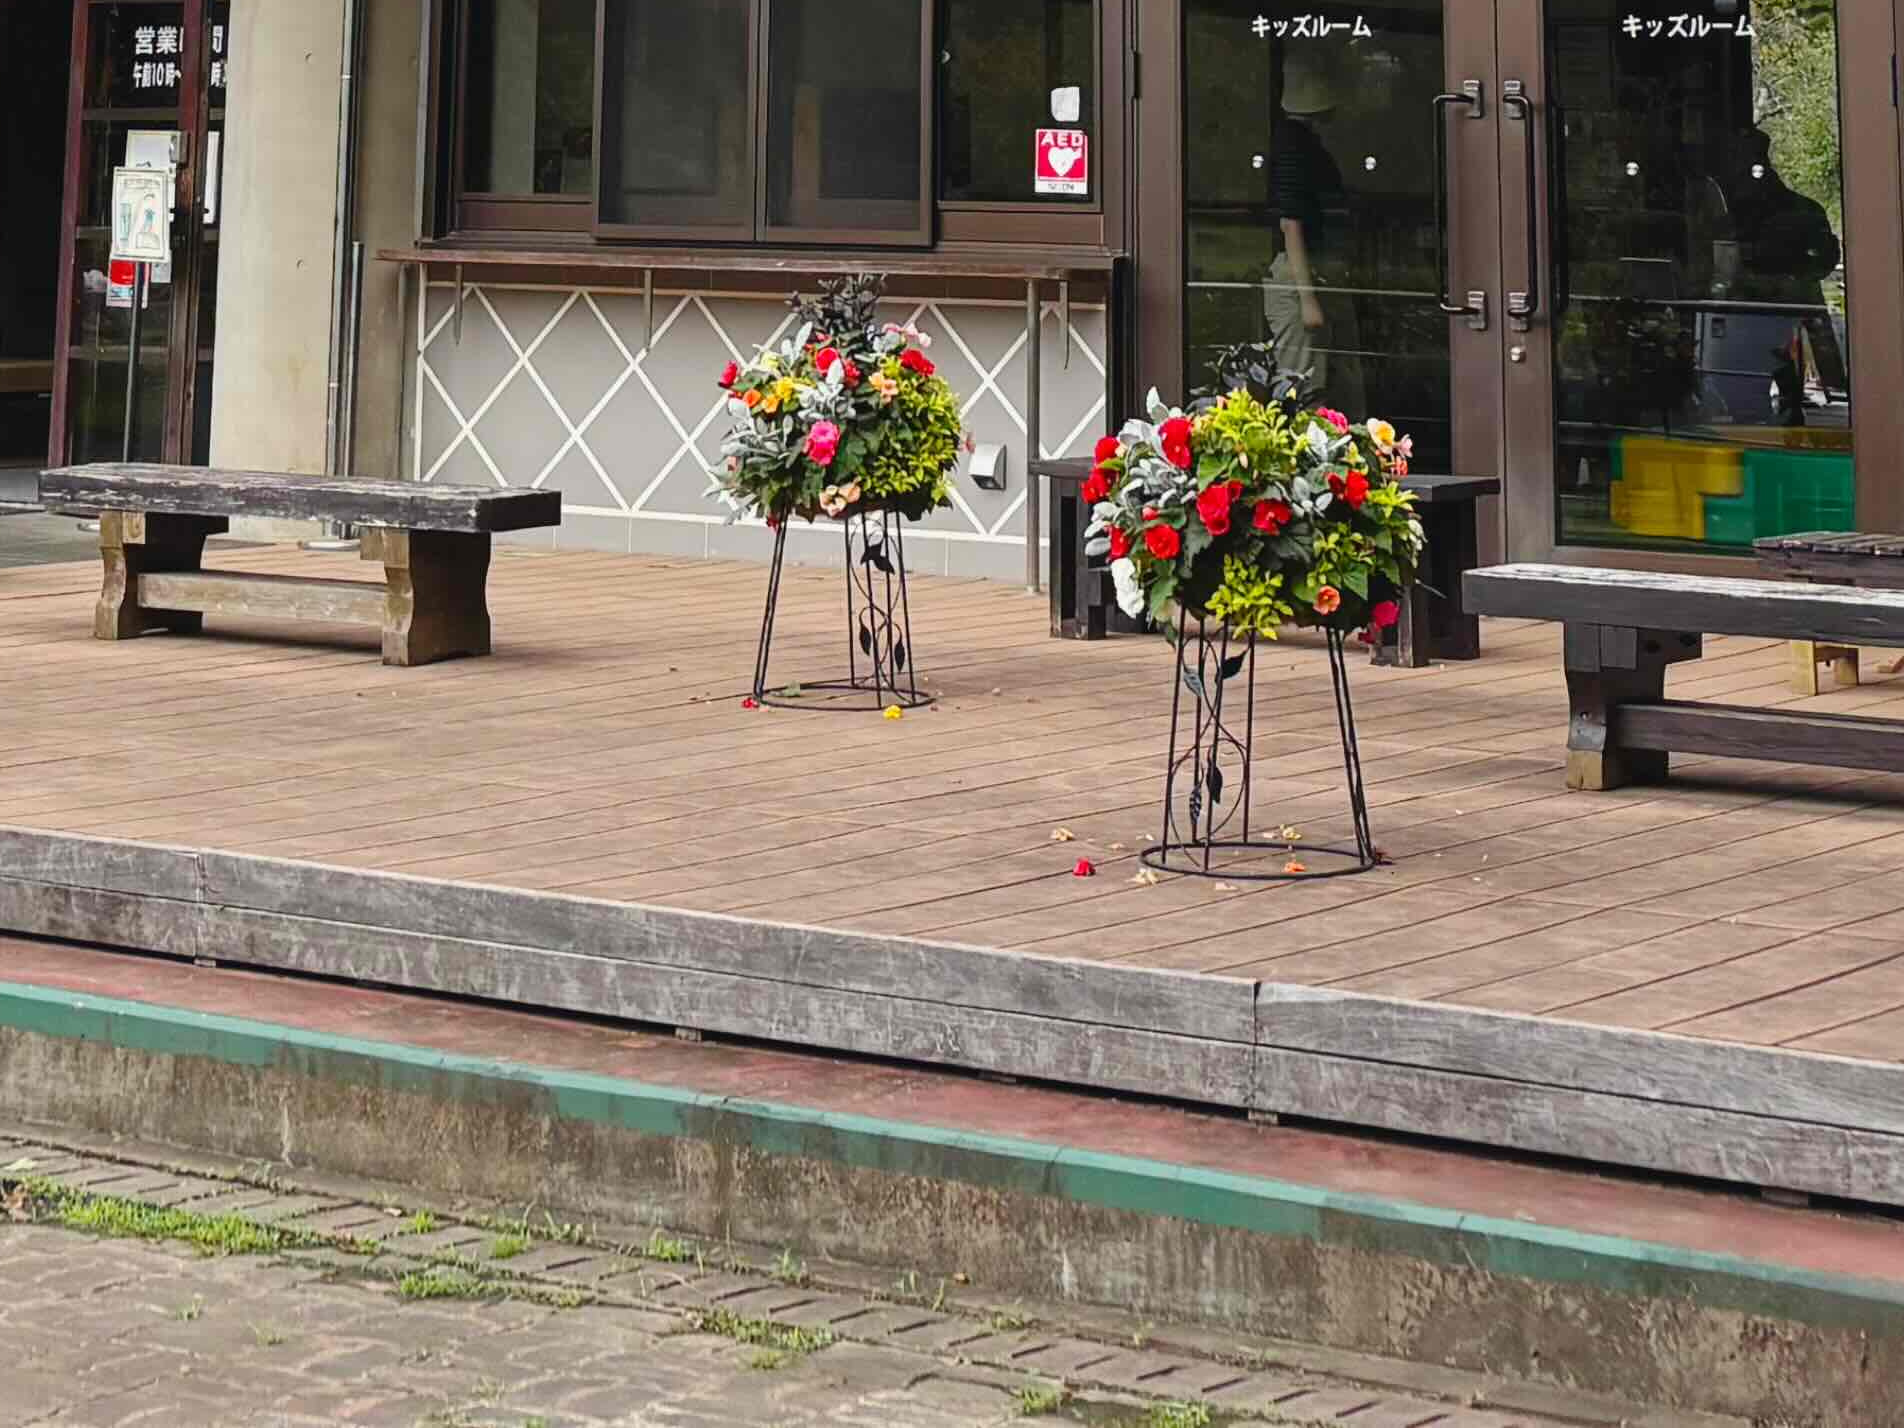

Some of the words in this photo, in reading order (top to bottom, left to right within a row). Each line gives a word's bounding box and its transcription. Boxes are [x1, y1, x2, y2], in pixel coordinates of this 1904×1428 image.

[1251, 13, 1372, 38] キッズルーム
[1622, 13, 1757, 38] キッズルーム
[1040, 132, 1084, 147] AED
